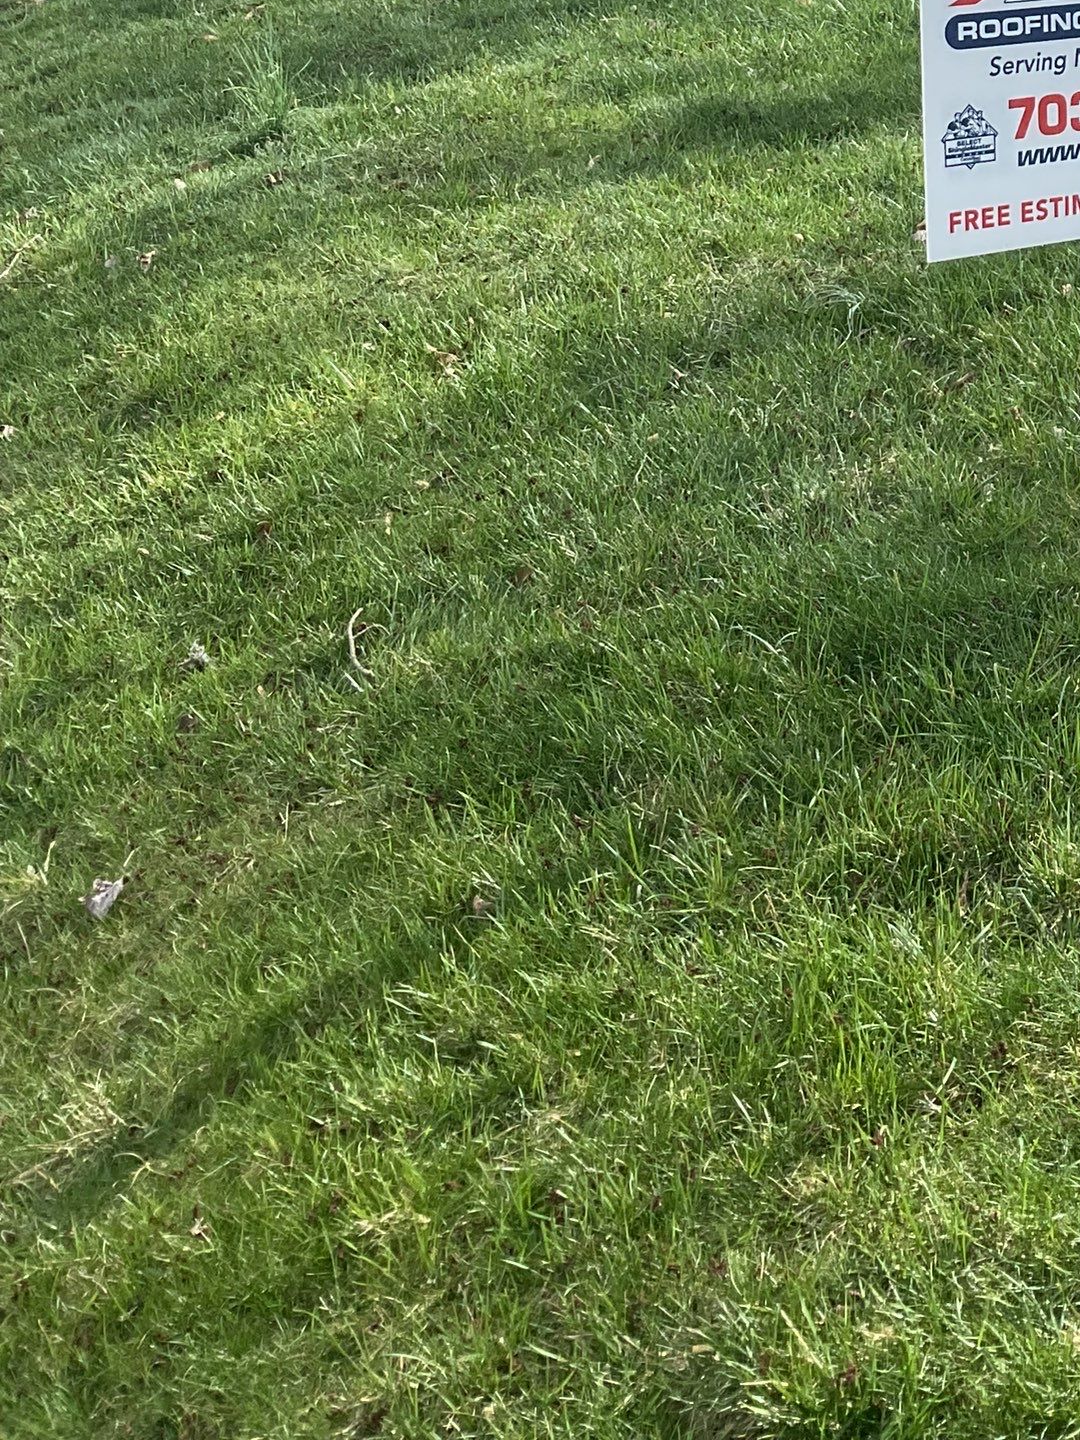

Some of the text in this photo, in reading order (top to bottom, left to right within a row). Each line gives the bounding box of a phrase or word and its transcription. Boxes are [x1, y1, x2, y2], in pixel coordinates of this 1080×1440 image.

[990, 52, 1066, 76] Serving
[956, 138, 982, 147] SELECT
[950, 205, 1010, 233] FREE
